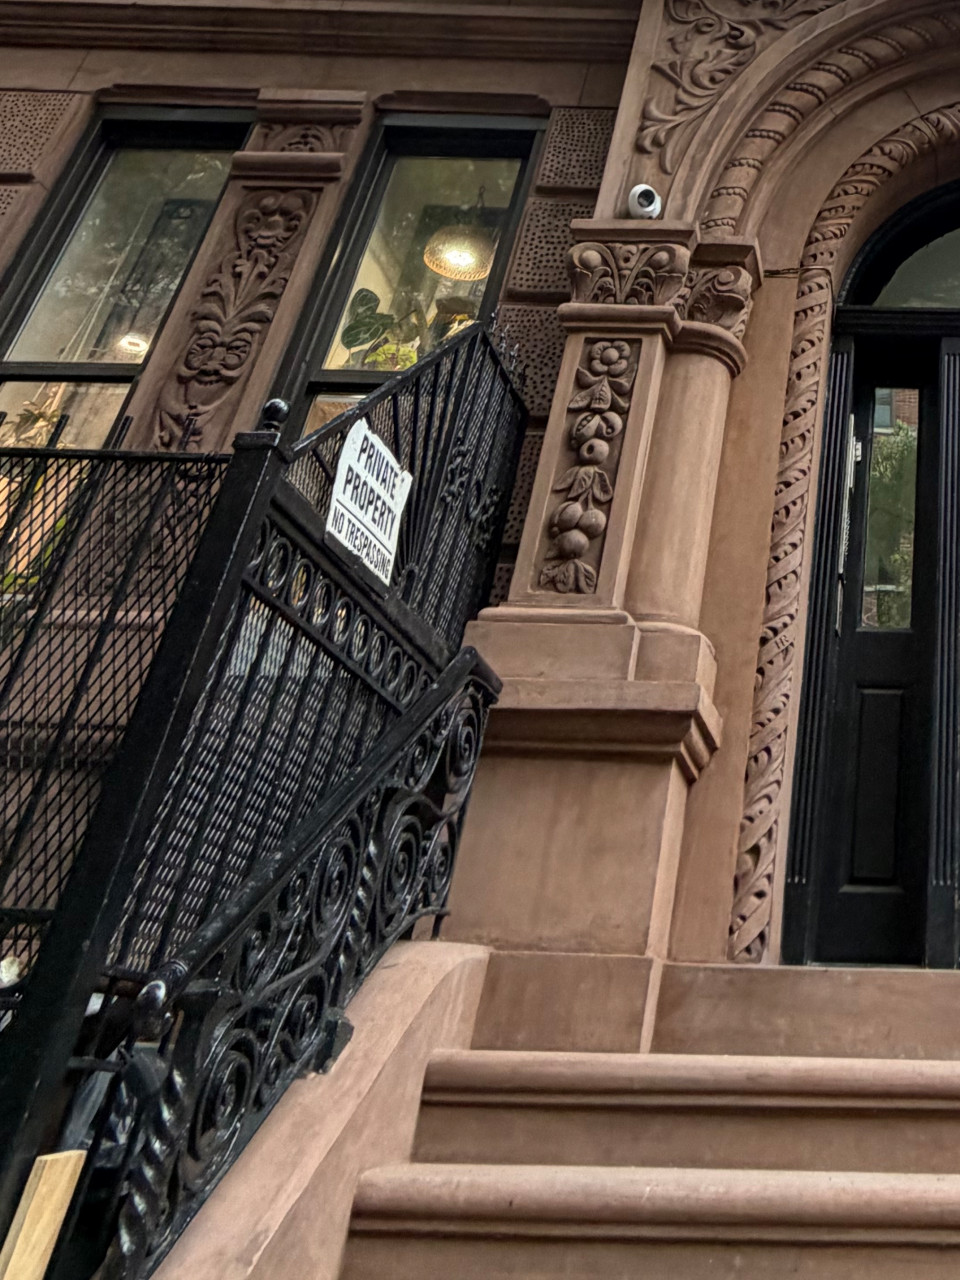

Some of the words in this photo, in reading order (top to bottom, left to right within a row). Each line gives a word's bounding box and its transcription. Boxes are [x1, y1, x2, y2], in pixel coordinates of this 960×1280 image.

[342, 463, 397, 541] PROPERTY
[357, 434, 398, 500] PRIVATE
[331, 505, 345, 535] NO
[345, 518, 391, 580] TRESPASSING
